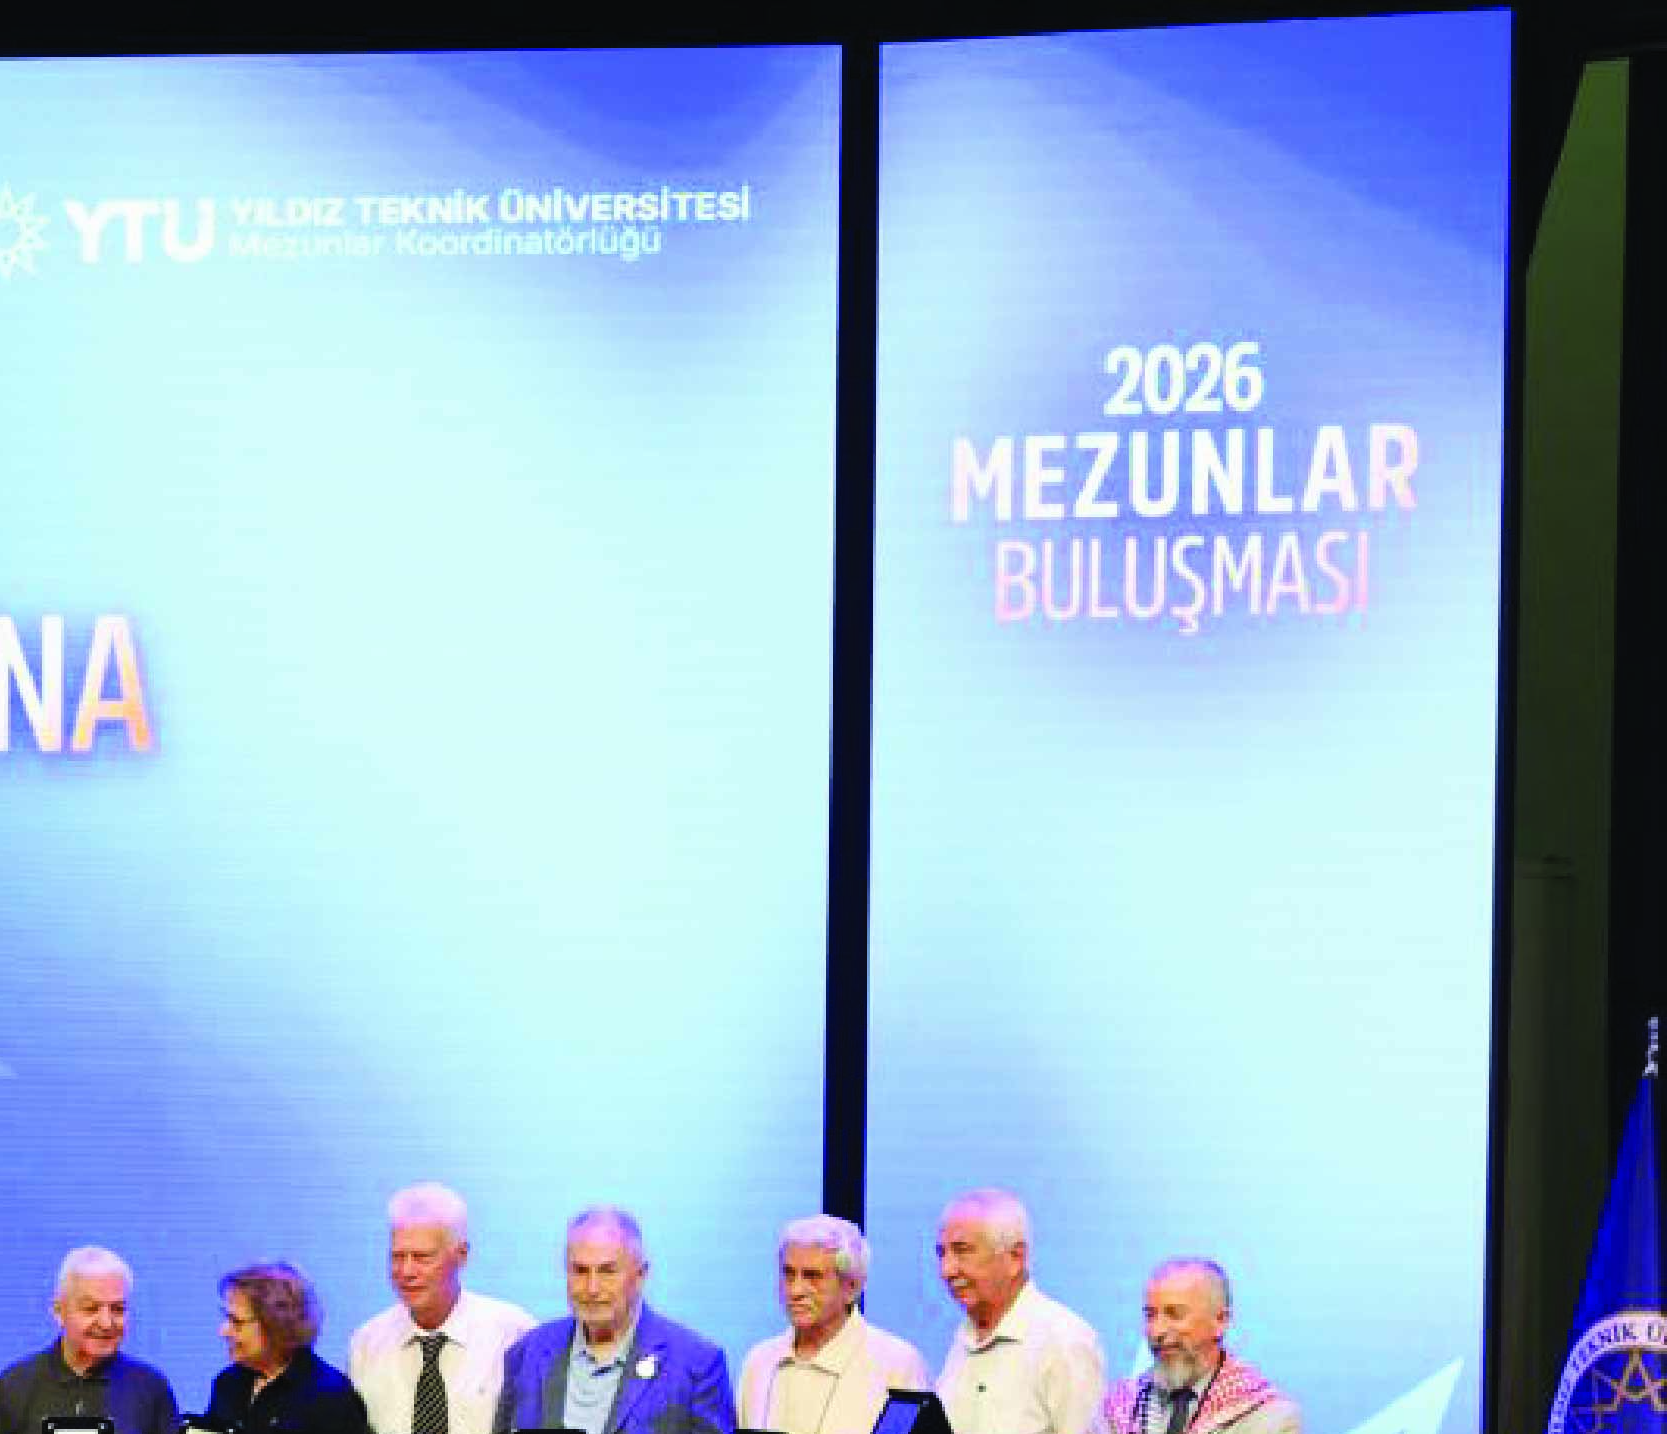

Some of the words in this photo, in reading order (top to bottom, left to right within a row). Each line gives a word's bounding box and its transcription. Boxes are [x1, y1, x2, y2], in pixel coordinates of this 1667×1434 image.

[65, 198, 216, 264] YTU
[229, 197, 345, 227] YILDIZ
[354, 188, 489, 225] TEKNİK
[499, 184, 750, 224] ÜNİVERSİTESİ
[229, 230, 385, 257] Mezunlar
[396, 224, 662, 261] Koordinatörlüğü
[1104, 342, 1264, 415] 2026
[952, 424, 1418, 522] MEZUNLAR
[994, 531, 1369, 634] BULUŞMASI
